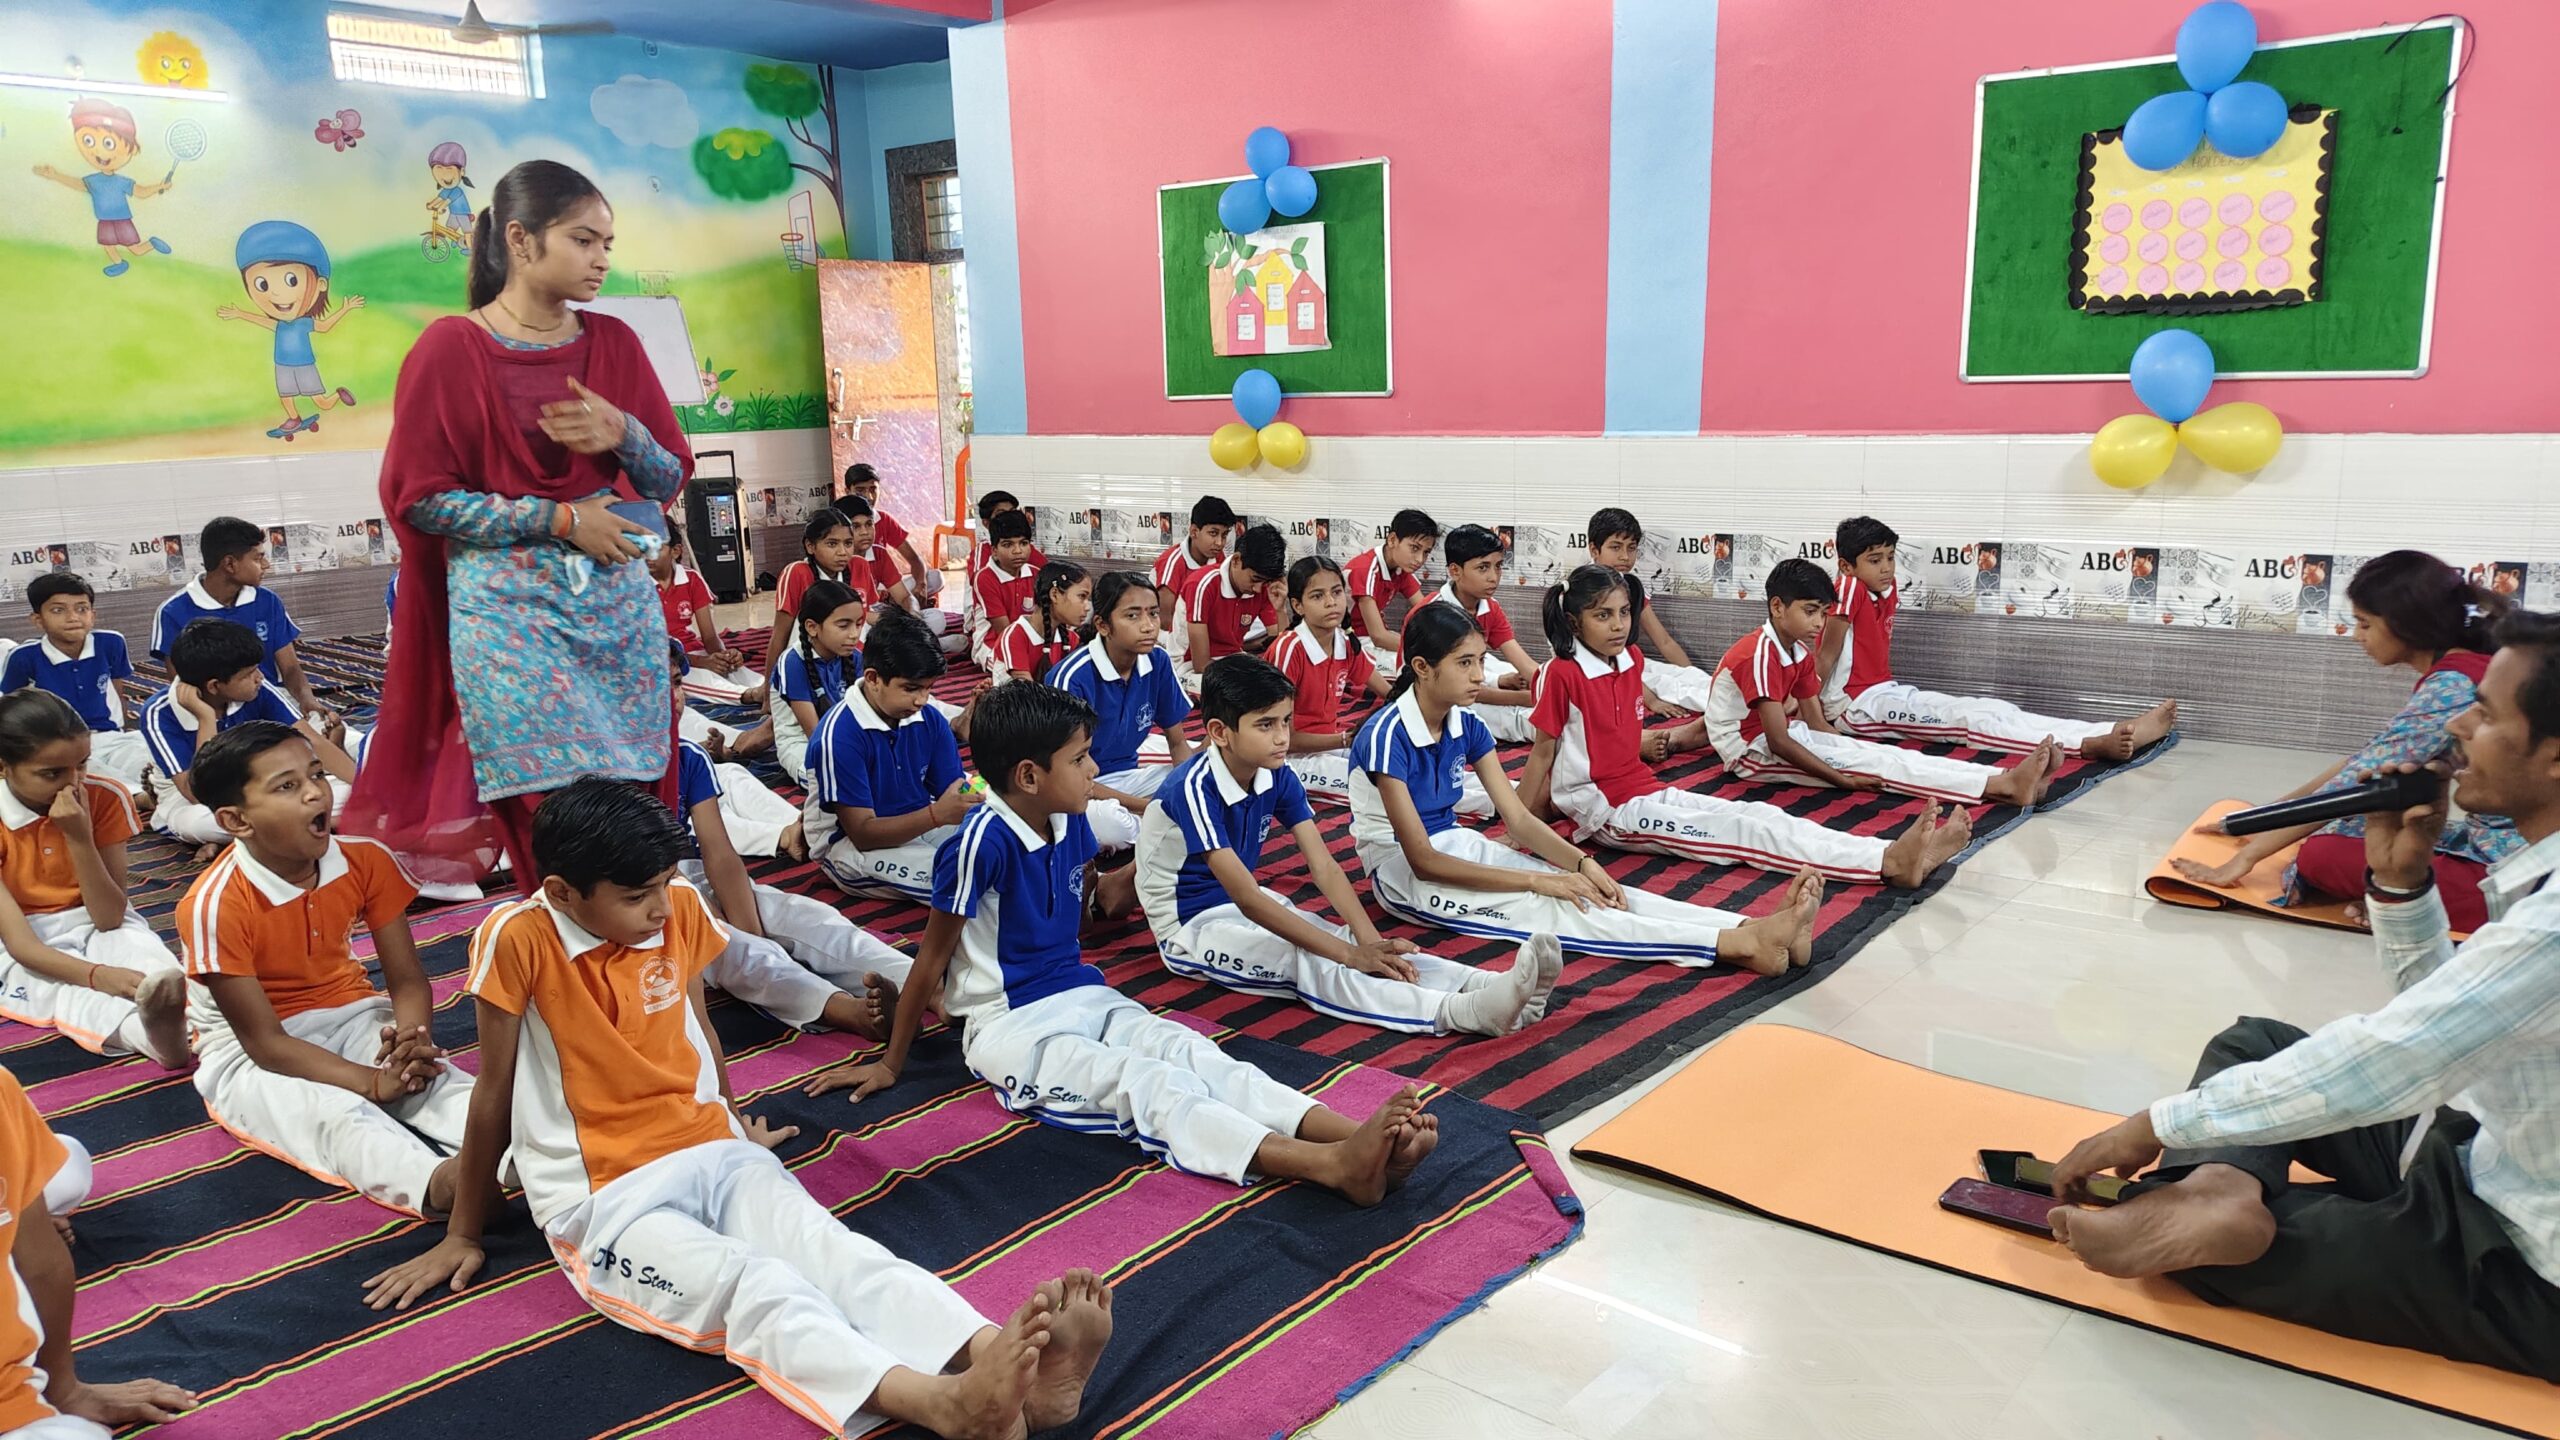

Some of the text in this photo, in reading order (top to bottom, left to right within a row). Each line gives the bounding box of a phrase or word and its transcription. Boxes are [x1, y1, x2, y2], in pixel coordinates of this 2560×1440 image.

[808, 486, 828, 498] ABC
[1069, 509, 1089, 525] ABC
[1137, 513, 1158, 529] ABC
[336, 522, 364, 537] ABC
[1290, 519, 1314, 536] ABC
[1374, 525, 1391, 540] AB
[129, 540, 161, 555] ABC
[1567, 533, 1587, 549] AB
[1677, 536, 1710, 554] ABC
[11, 549, 46, 566] ABC
[1797, 541, 1834, 560] ABC
[1931, 546, 1973, 565] ABC
[2080, 551, 2127, 572] ABC
[2245, 558, 2294, 580] ABC
[1888, 711, 1916, 722] OPS
[1300, 773, 1327, 786] OPS
[1639, 817, 1676, 832] OPS
[874, 860, 910, 878] OPS
[1429, 895, 1469, 915] OPS
[1004, 1075, 1040, 1100] OPS
